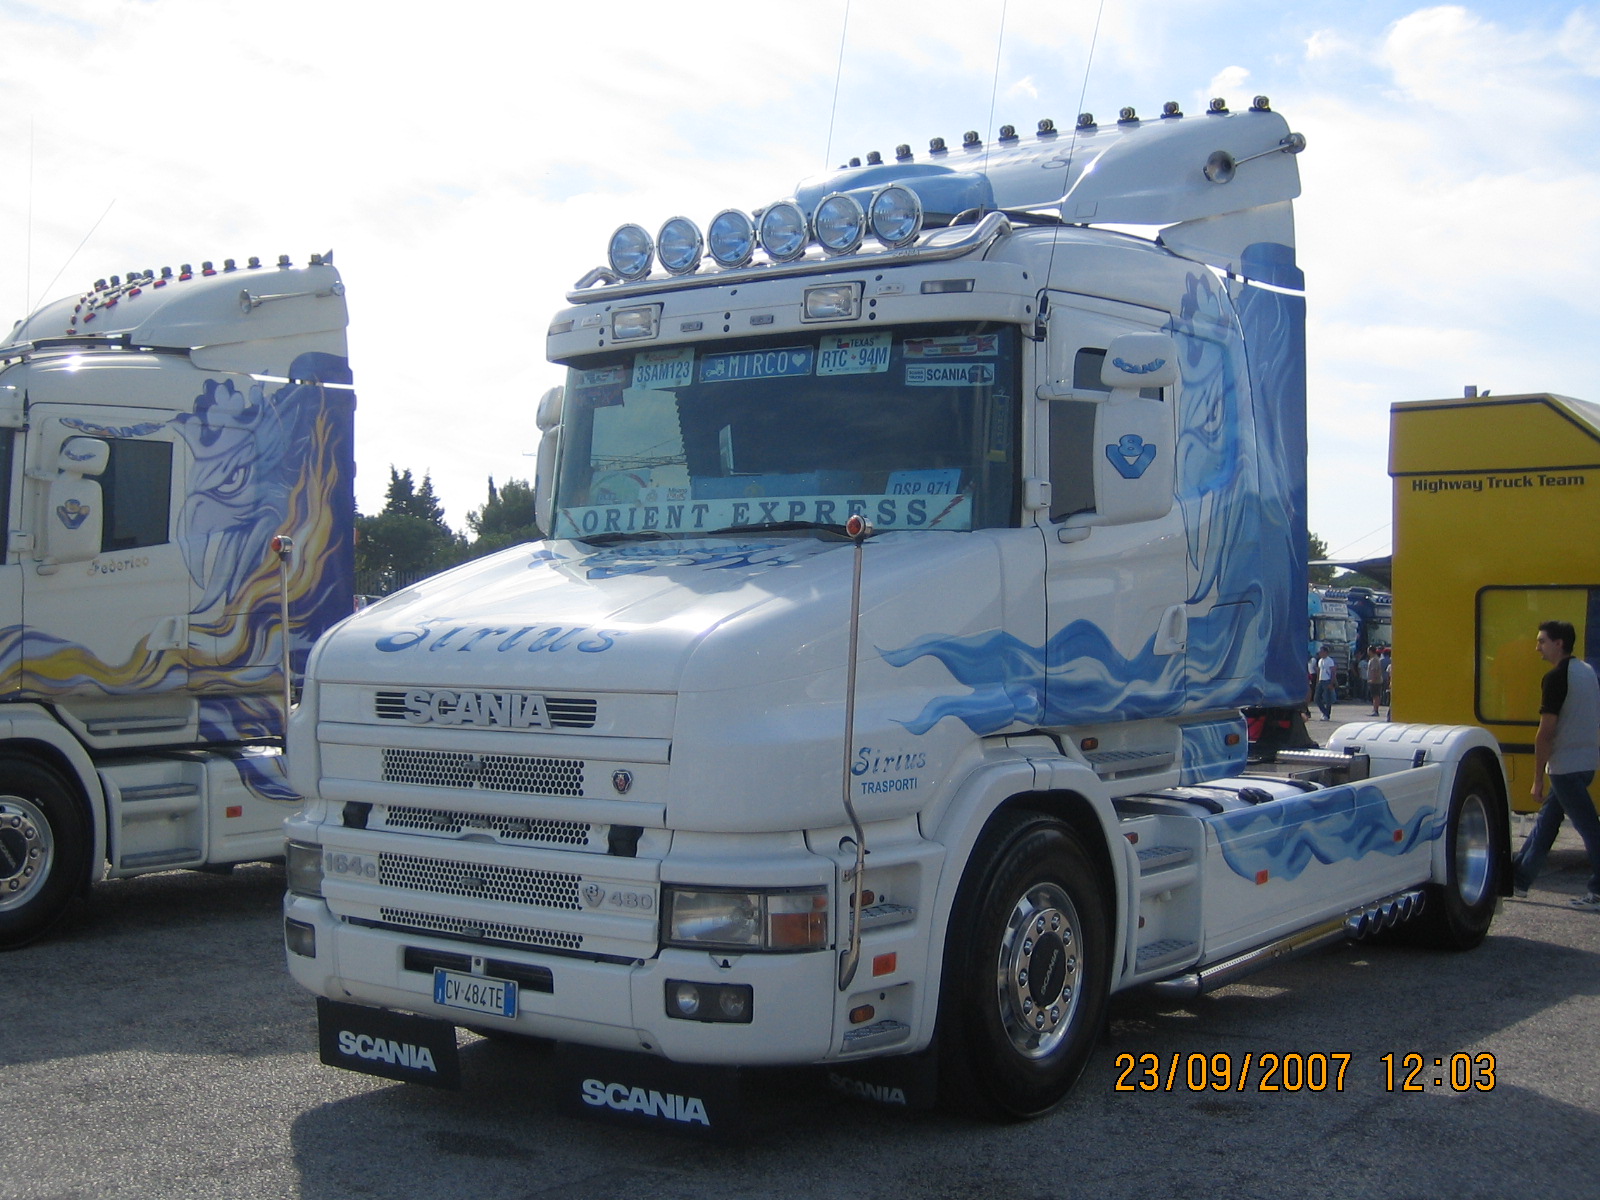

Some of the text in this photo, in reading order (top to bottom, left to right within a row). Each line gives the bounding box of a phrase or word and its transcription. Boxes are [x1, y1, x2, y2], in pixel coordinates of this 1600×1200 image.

[850, 338, 875, 348] TEXAS
[728, 352, 788, 377] MIRCO
[821, 347, 888, 369] RTC 94M
[636, 361, 691, 383] 3SAM123
[926, 368, 968, 381] SCANIA
[1412, 474, 1585, 494] Highway Truck Team
[582, 498, 928, 533] ORIENT EXPRESS
[374, 617, 629, 653] Sirius
[403, 689, 553, 729] SCANIA
[851, 746, 927, 776] Sirius
[861, 777, 918, 795] TRASPORTI
[338, 1030, 437, 1072] SCANIA
[581, 1078, 711, 1126] SCANIA
